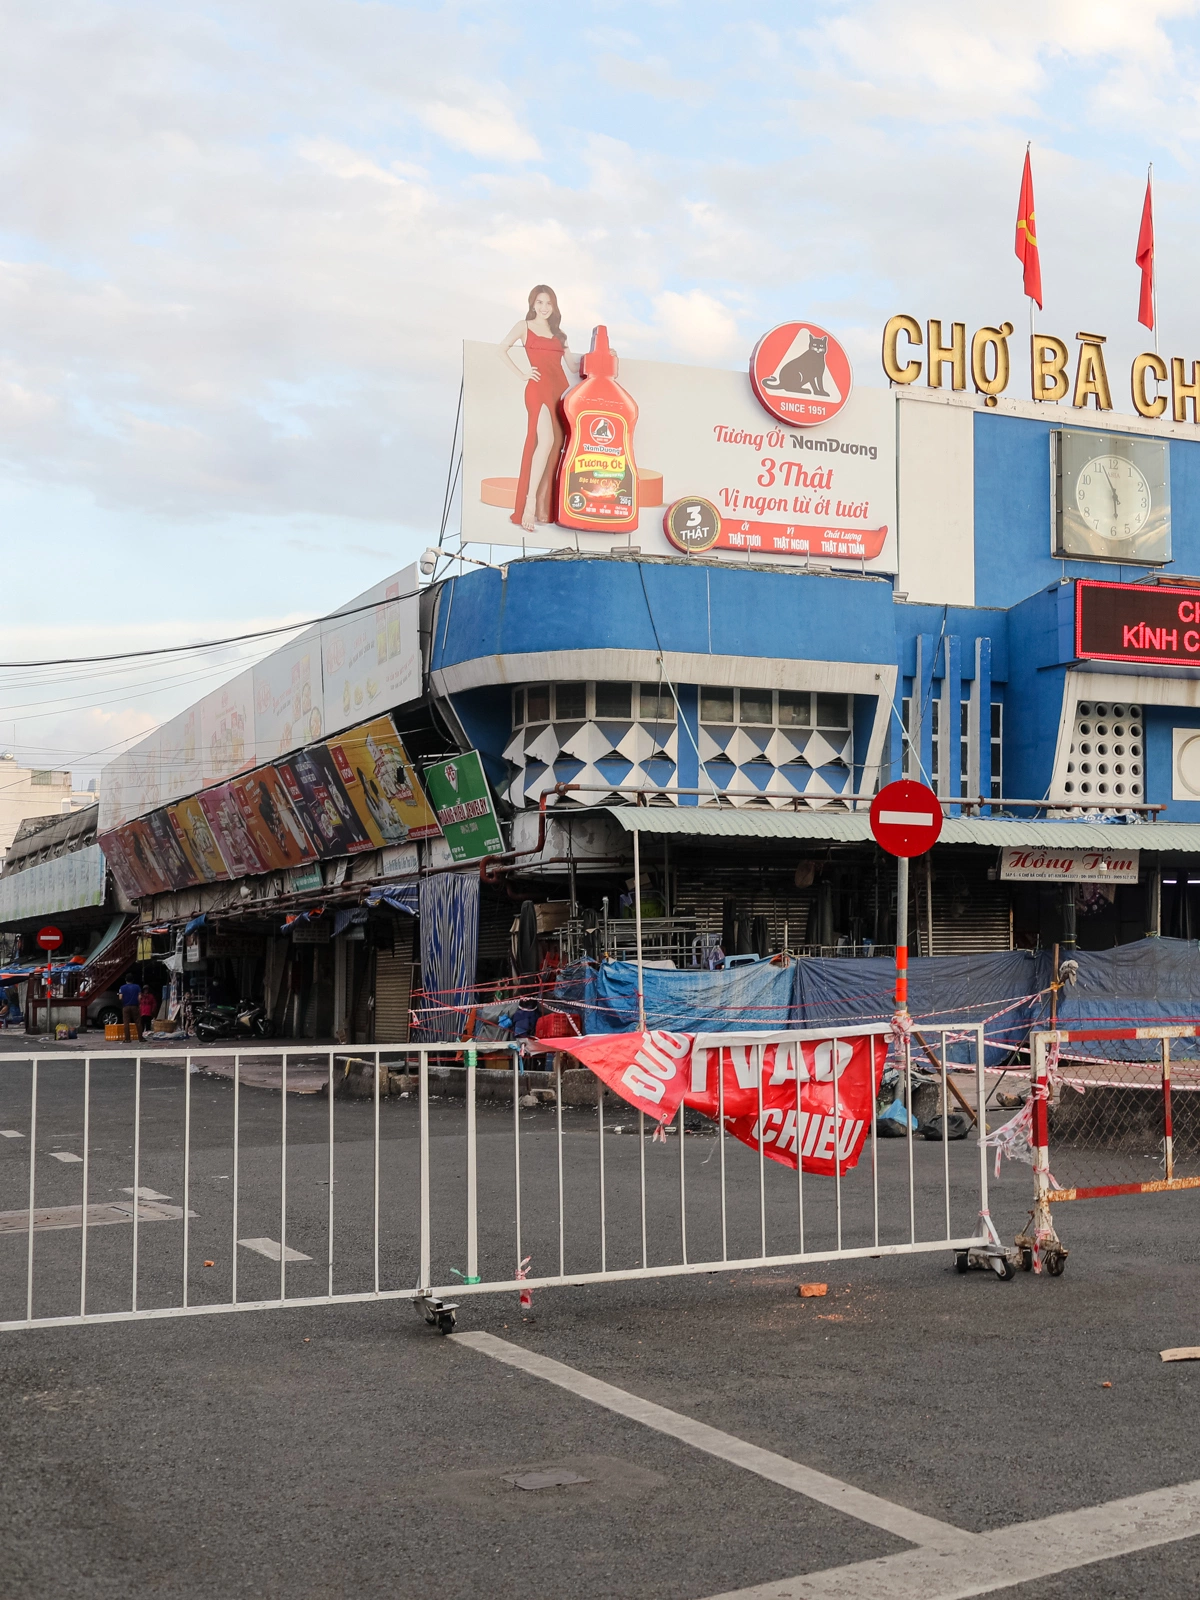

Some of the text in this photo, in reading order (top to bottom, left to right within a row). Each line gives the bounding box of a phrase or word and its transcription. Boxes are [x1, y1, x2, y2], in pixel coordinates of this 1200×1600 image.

[881, 313, 1014, 408] CHỢ
[780, 401, 826, 416] SINCE 1951
[713, 424, 878, 460] Tương Ớt NamDương
[1094, 462, 1102, 473] 11
[1109, 459, 1118, 470] 12
[757, 457, 834, 493] 3 Thật
[1128, 467, 1132, 478] 1
[1082, 474, 1092, 485] 10
[1138, 482, 1144, 492] 2
[1078, 490, 1085, 500] 9
[718, 487, 870, 519] Vị ngon từ ớt tươi
[1140, 498, 1147, 508] 3
[685, 505, 702, 527] 3
[1084, 507, 1090, 518] 8
[1135, 513, 1141, 523] 4
[1093, 519, 1099, 530] 7
[1124, 524, 1130, 534] 5
[680, 526, 709, 541] THẬT
[1110, 526, 1116, 536] 6
[728, 533, 746, 547] THẬT
[773, 536, 810, 551] THẬT NGON
[821, 540, 837, 554] THẬT
[838, 542, 848, 554] AN
[1123, 622, 1177, 651] KÍNH
[1008, 851, 1074, 872] Hồng
